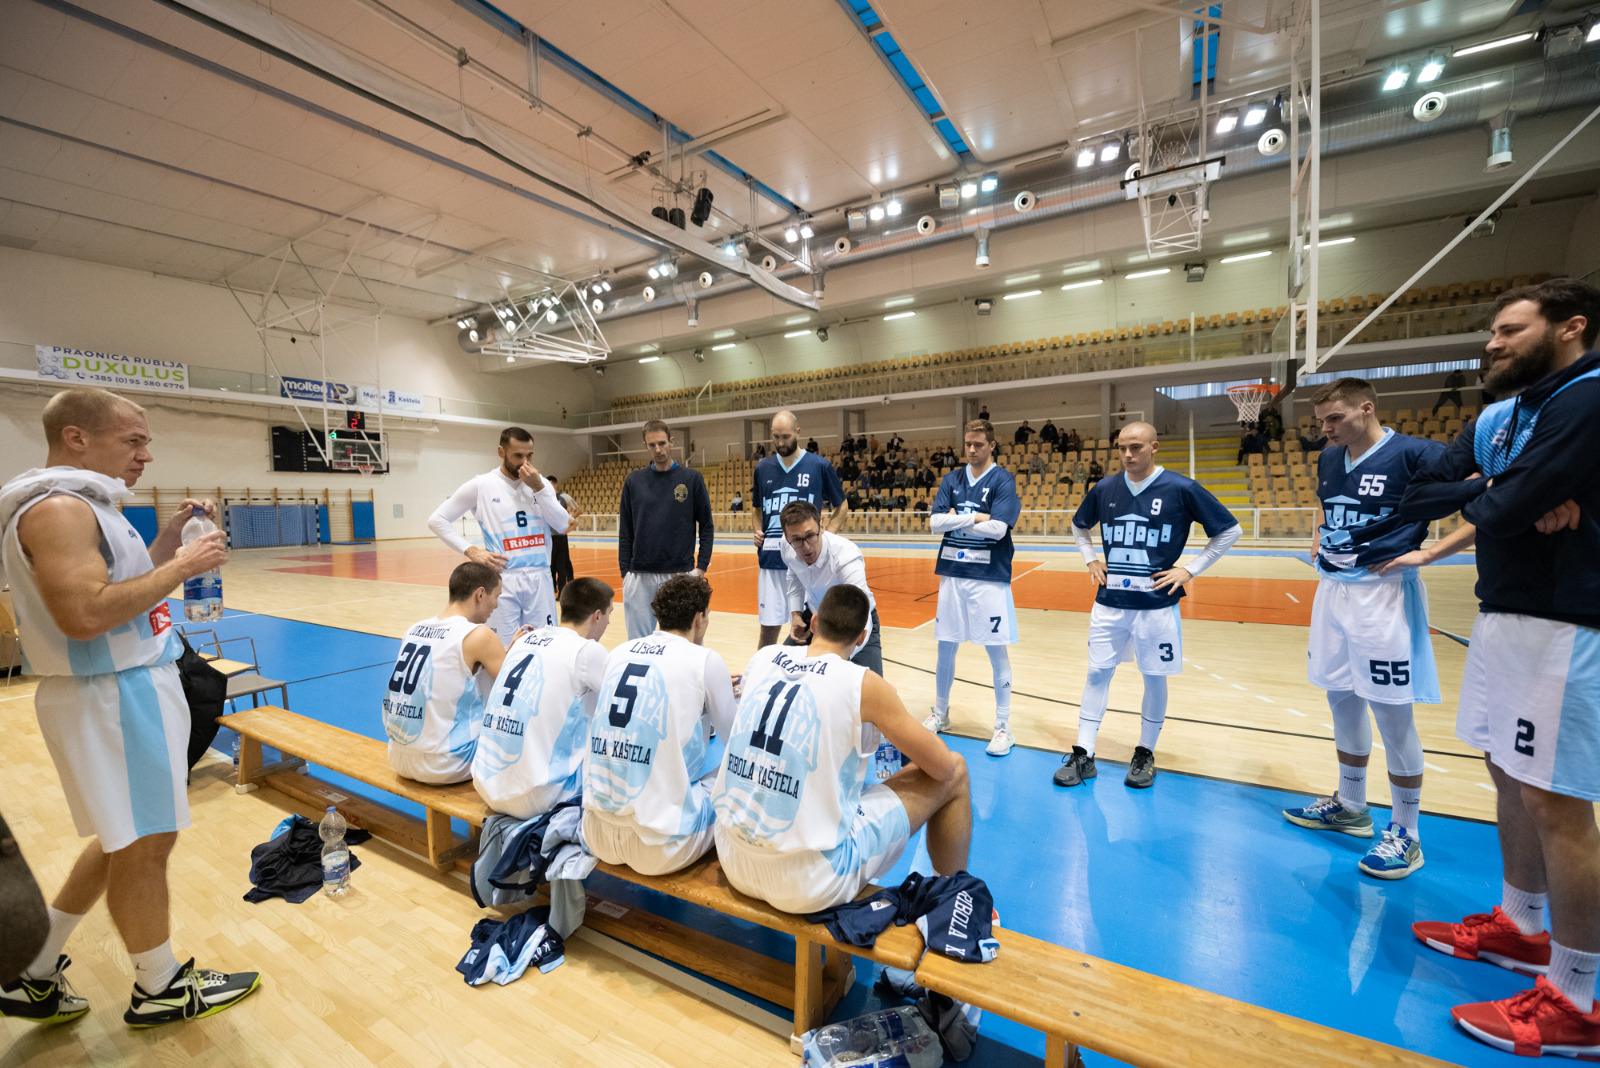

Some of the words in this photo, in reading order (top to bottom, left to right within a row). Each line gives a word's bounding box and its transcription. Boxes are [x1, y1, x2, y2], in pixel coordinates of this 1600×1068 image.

[53, 346, 130, 362] PRAONICA
[134, 357, 184, 369] RUBLJA
[62, 356, 185, 382] DUXULUS
[90, 374, 112, 382] +385
[163, 382, 184, 390] 6776
[363, 391, 386, 400] Maria
[797, 473, 810, 488] 16
[1358, 474, 1387, 497] 55
[981, 487, 990, 502] 7
[1150, 498, 1162, 516] 9
[516, 511, 527, 527] 6
[509, 537, 544, 549] Ribola
[990, 616, 1002, 633] 7
[1158, 643, 1174, 662] 3
[389, 643, 431, 695] 20
[503, 653, 535, 707] 4
[1369, 659, 1410, 686] 55
[608, 663, 650, 729] 5
[750, 680, 801, 746] 11
[1514, 717, 1536, 757] 2
[612, 739, 651, 765] KAŠTELA
[948, 890, 973, 940] RIBOLA
